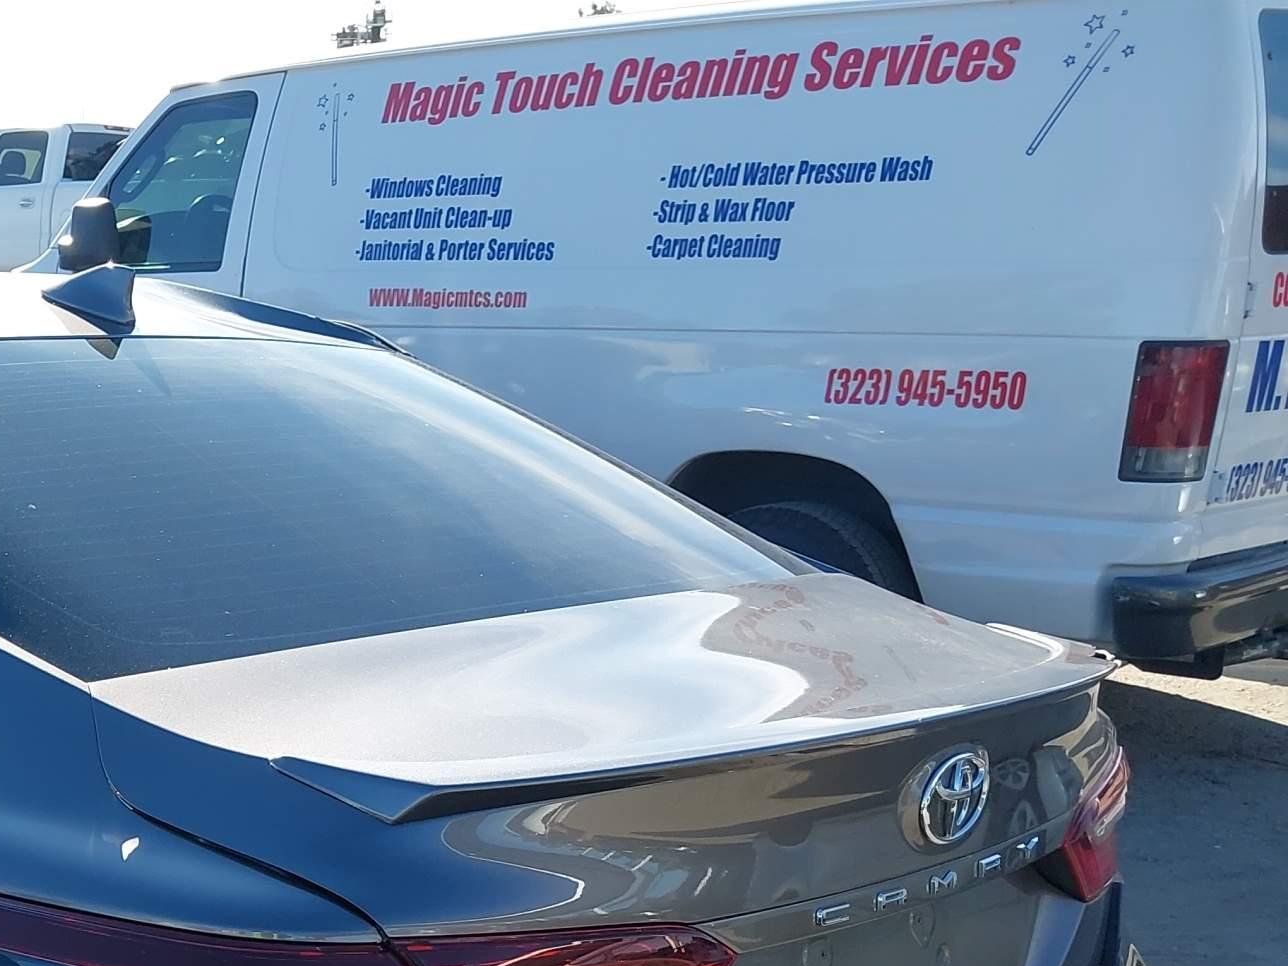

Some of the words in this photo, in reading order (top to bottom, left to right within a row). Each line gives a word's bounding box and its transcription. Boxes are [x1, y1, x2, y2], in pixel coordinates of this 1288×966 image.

[381, 75, 485, 125] Magic
[491, 62, 604, 115] Touch
[608, 49, 799, 105] Cleaning
[804, 35, 1021, 91] Services
[365, 177, 433, 199] -Windows
[435, 173, 502, 198] Cleaning
[667, 162, 739, 189] Hot/Cold
[742, 161, 795, 186] Water
[796, 159, 877, 184] Pressure
[880, 156, 933, 182] Wash
[360, 209, 413, 230] -Vacant
[414, 207, 441, 229] Unit
[445, 207, 512, 230] Clean-up
[653, 199, 697, 225] -Strip
[698, 202, 709, 222] &
[713, 199, 748, 223] Wax
[750, 198, 795, 222] Floor
[355, 240, 423, 261] -Janitorial
[425, 242, 435, 260] &
[438, 240, 485, 261] Porter
[487, 239, 555, 261] Services
[646, 234, 705, 260] -Carpet
[707, 234, 781, 260] Cleaning
[368, 288, 527, 309] WWW.Magicmtcs.com
[824, 368, 892, 406] (323)
[896, 370, 1027, 410] 945-5950
[1226, 462, 1262, 502] (323)
[813, 837, 1040, 926] CAMRY
